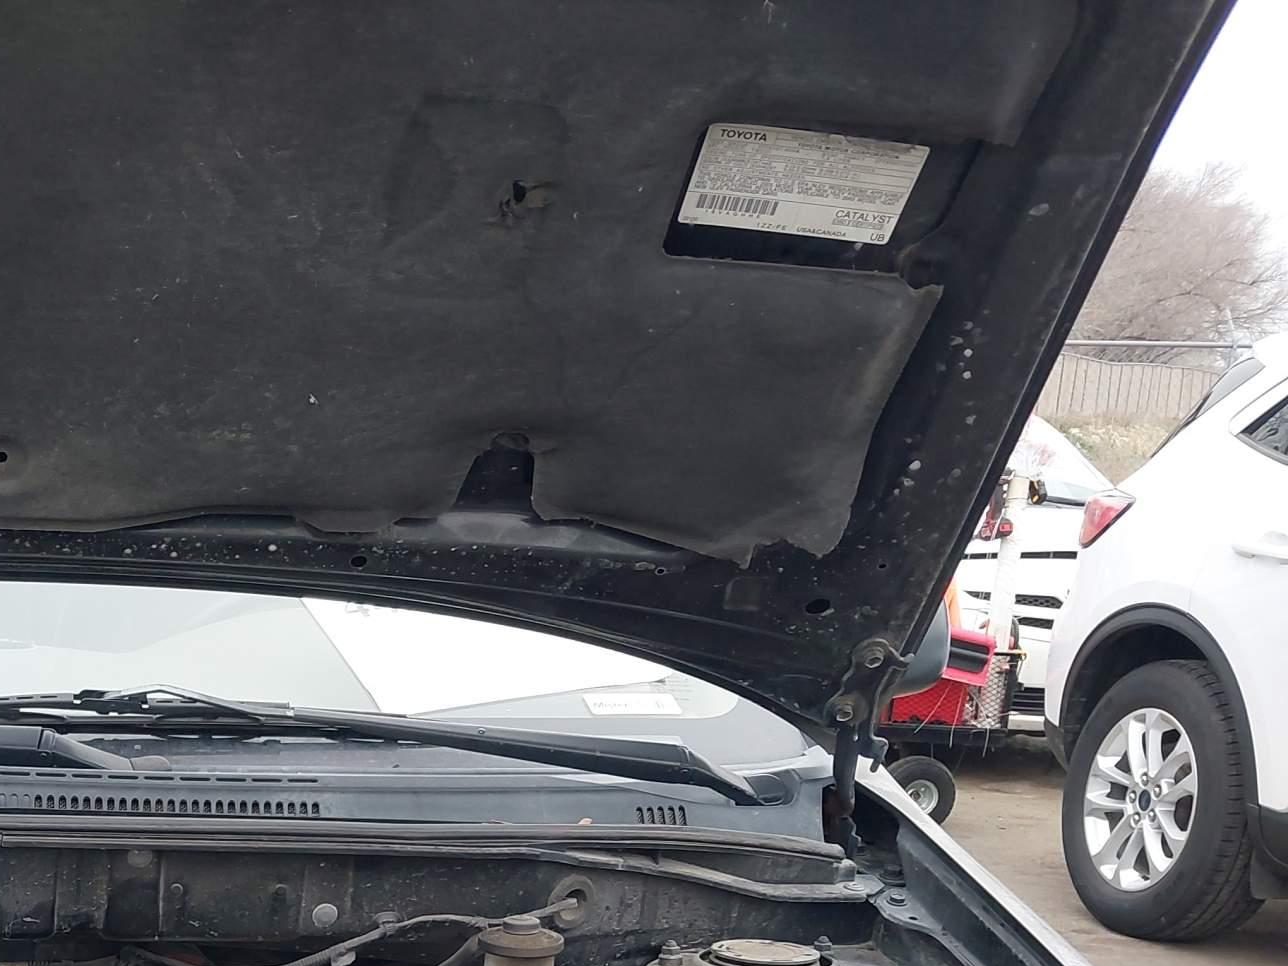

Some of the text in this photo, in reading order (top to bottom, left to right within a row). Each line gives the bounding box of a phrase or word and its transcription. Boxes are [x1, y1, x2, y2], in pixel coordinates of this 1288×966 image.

[719, 128, 768, 143] TOYOTA
[834, 209, 894, 225] CATALYST
[869, 232, 885, 242] UB
